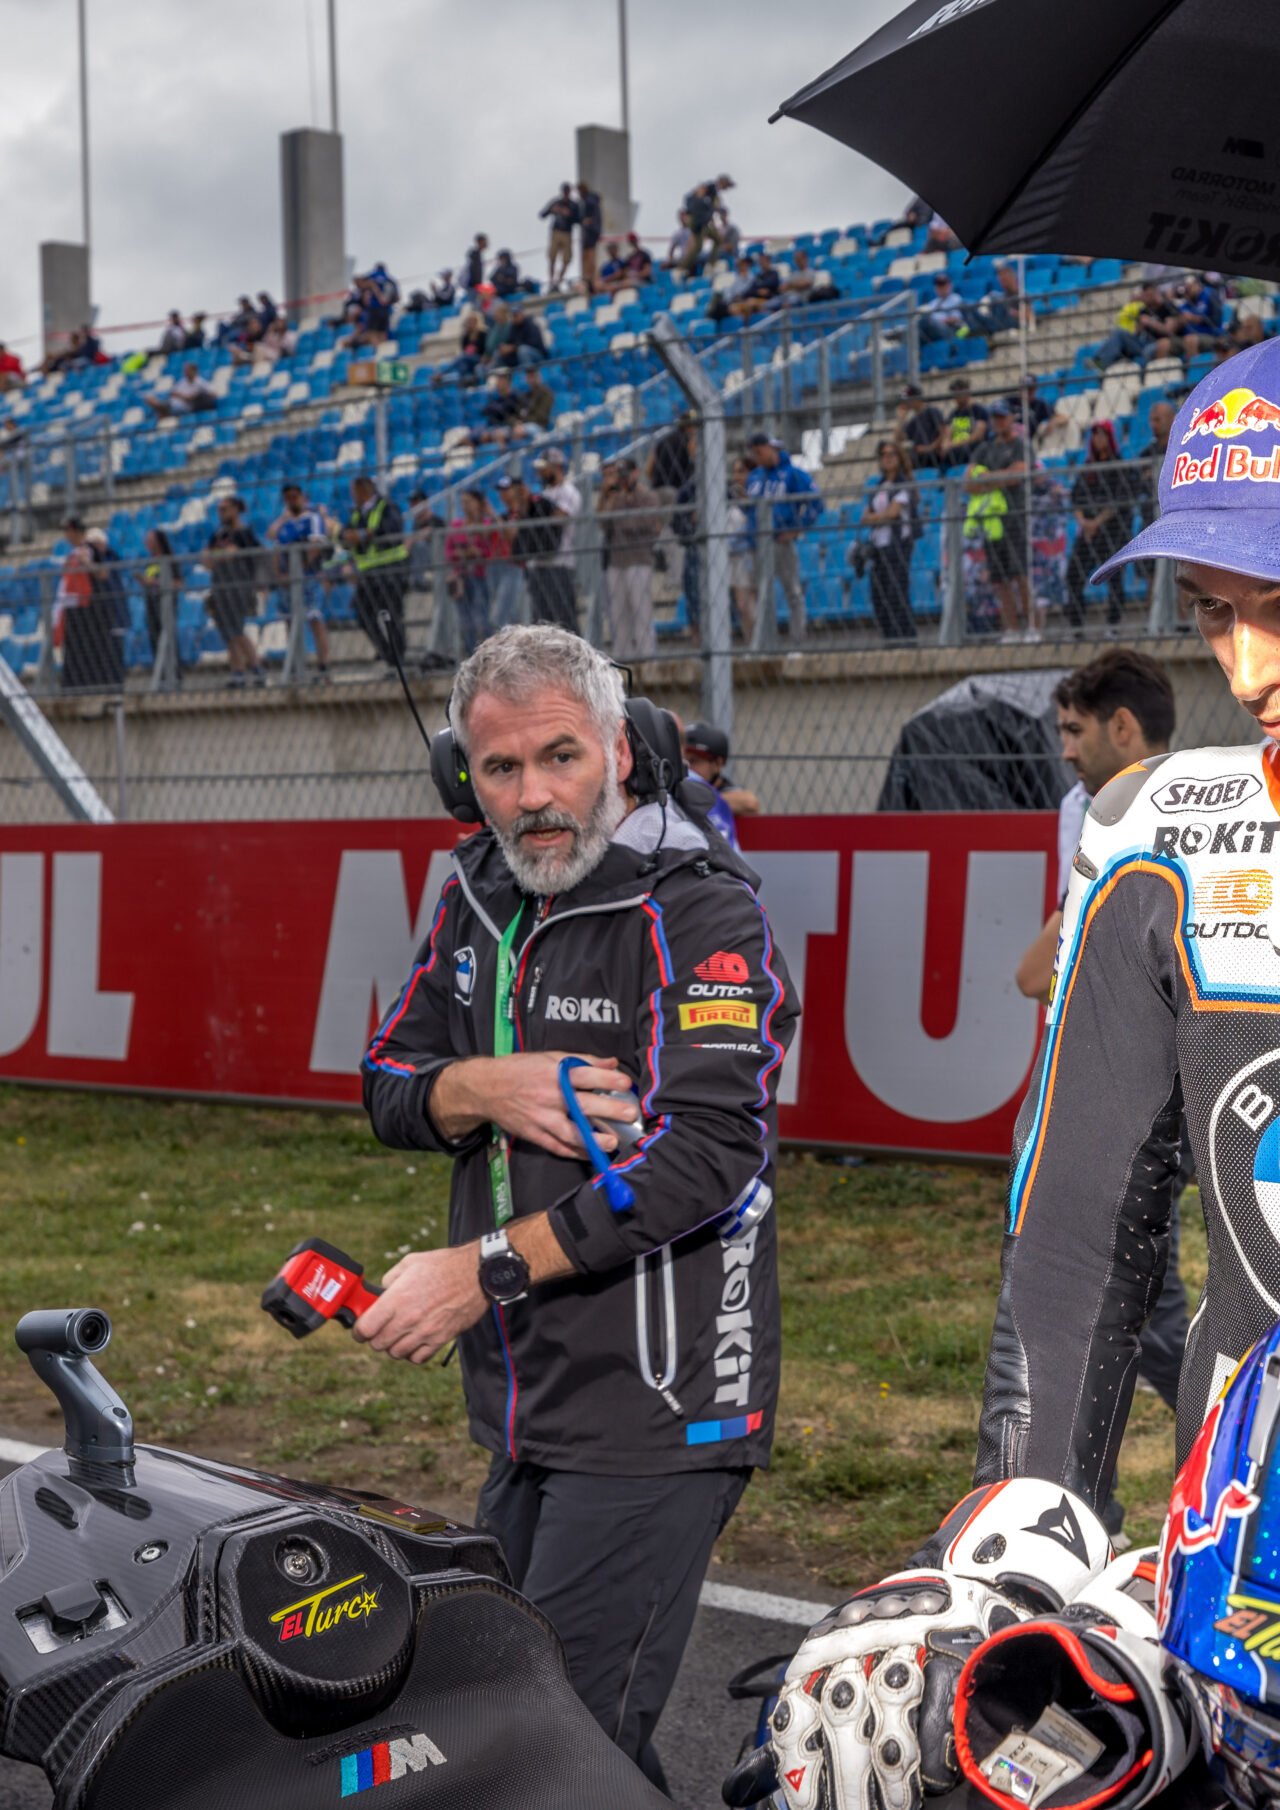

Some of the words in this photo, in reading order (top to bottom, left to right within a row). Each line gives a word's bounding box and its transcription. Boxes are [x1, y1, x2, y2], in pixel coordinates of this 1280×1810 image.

[1171, 444, 1222, 490] Red
[1165, 778, 1247, 807] SHOEI
[688, 1004, 751, 1024] PIRELLI
